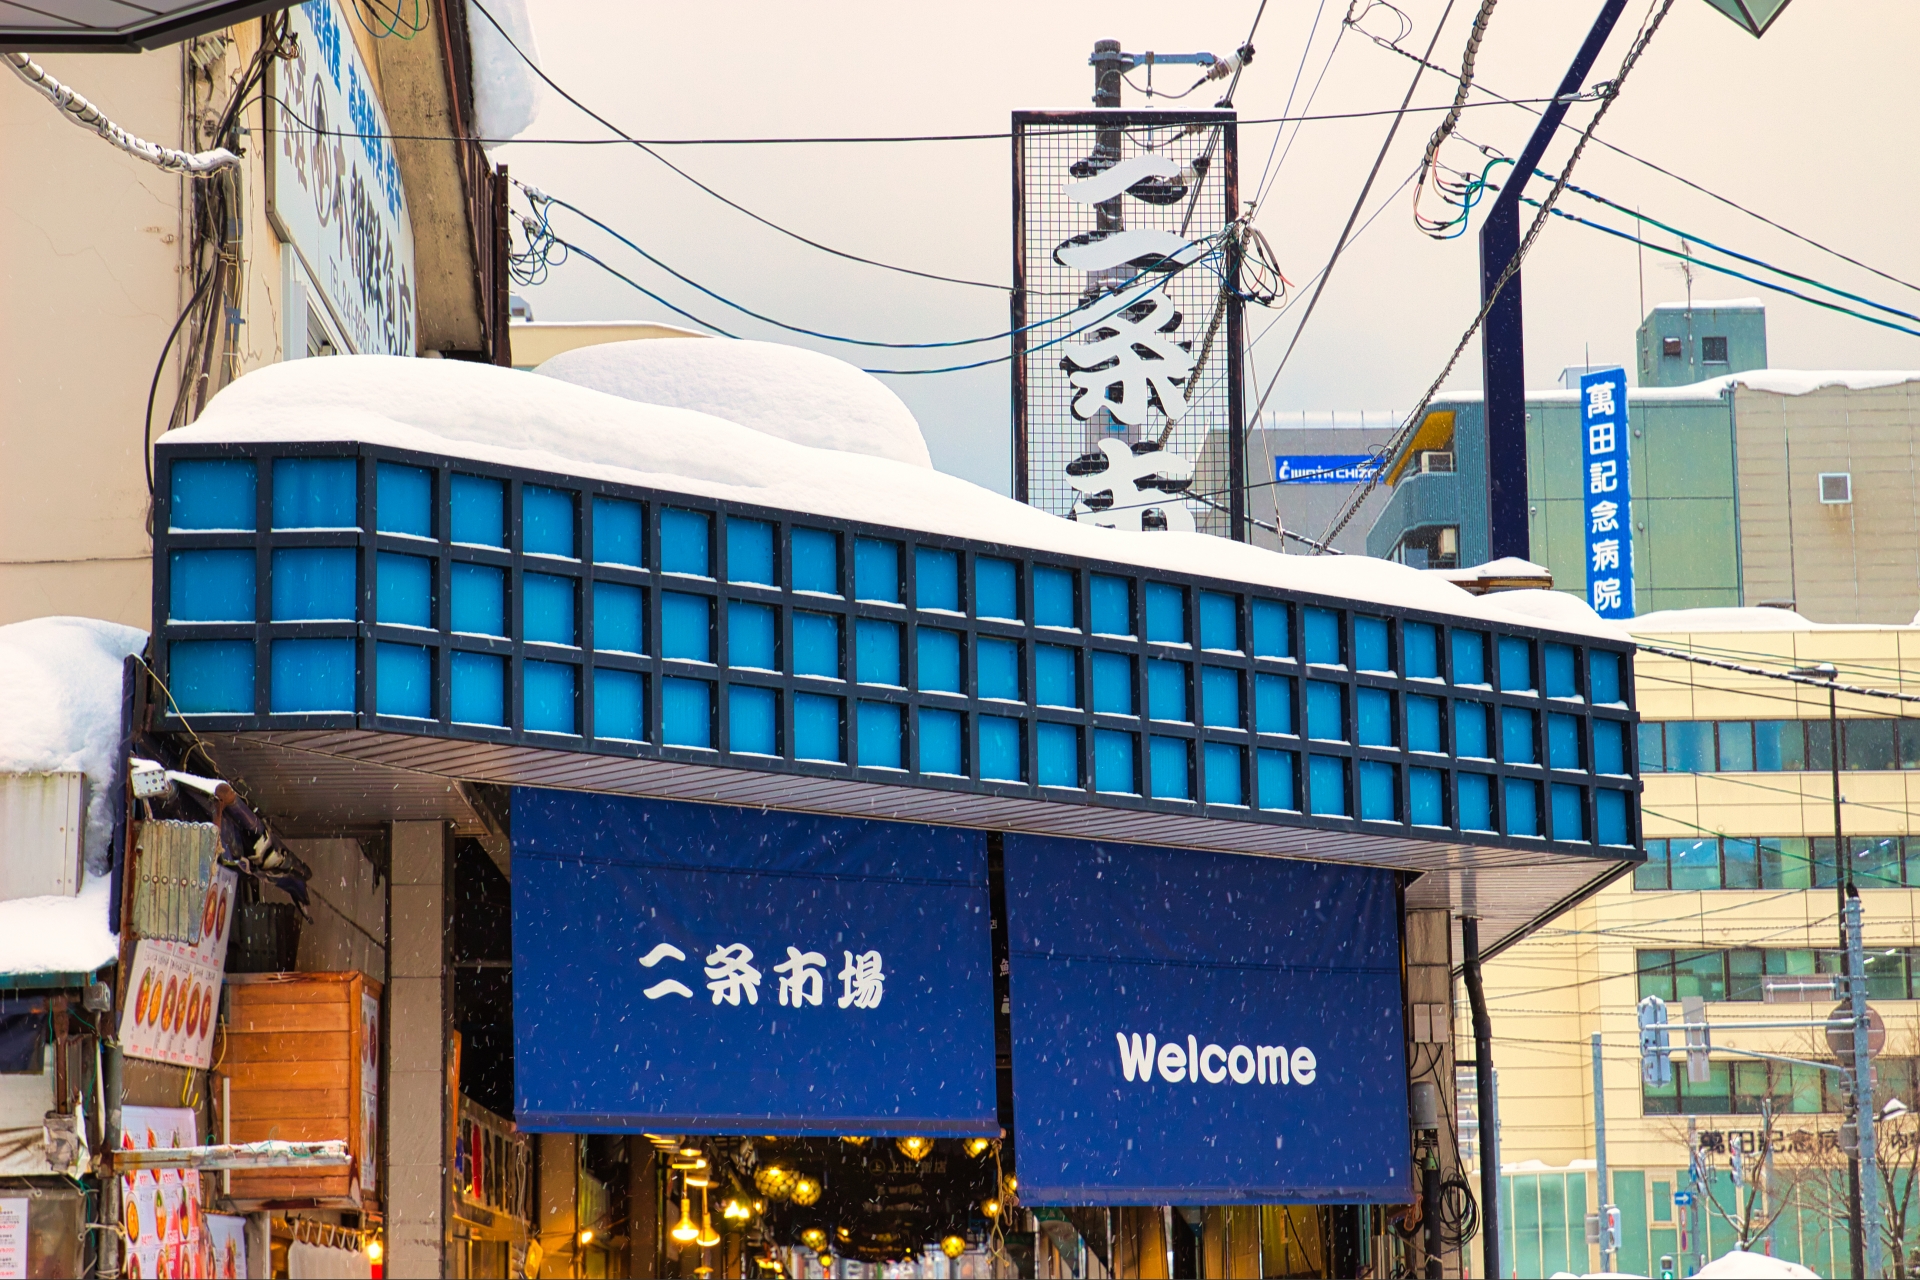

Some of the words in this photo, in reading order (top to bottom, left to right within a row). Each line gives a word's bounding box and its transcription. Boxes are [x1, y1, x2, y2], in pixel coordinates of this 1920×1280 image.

[1586, 382, 1621, 612] 萬田記念病院
[638, 942, 885, 1009] 二条市場
[1116, 1032, 1317, 1085] Welcome
[1697, 1129, 1843, 1155] 萬田記念病
